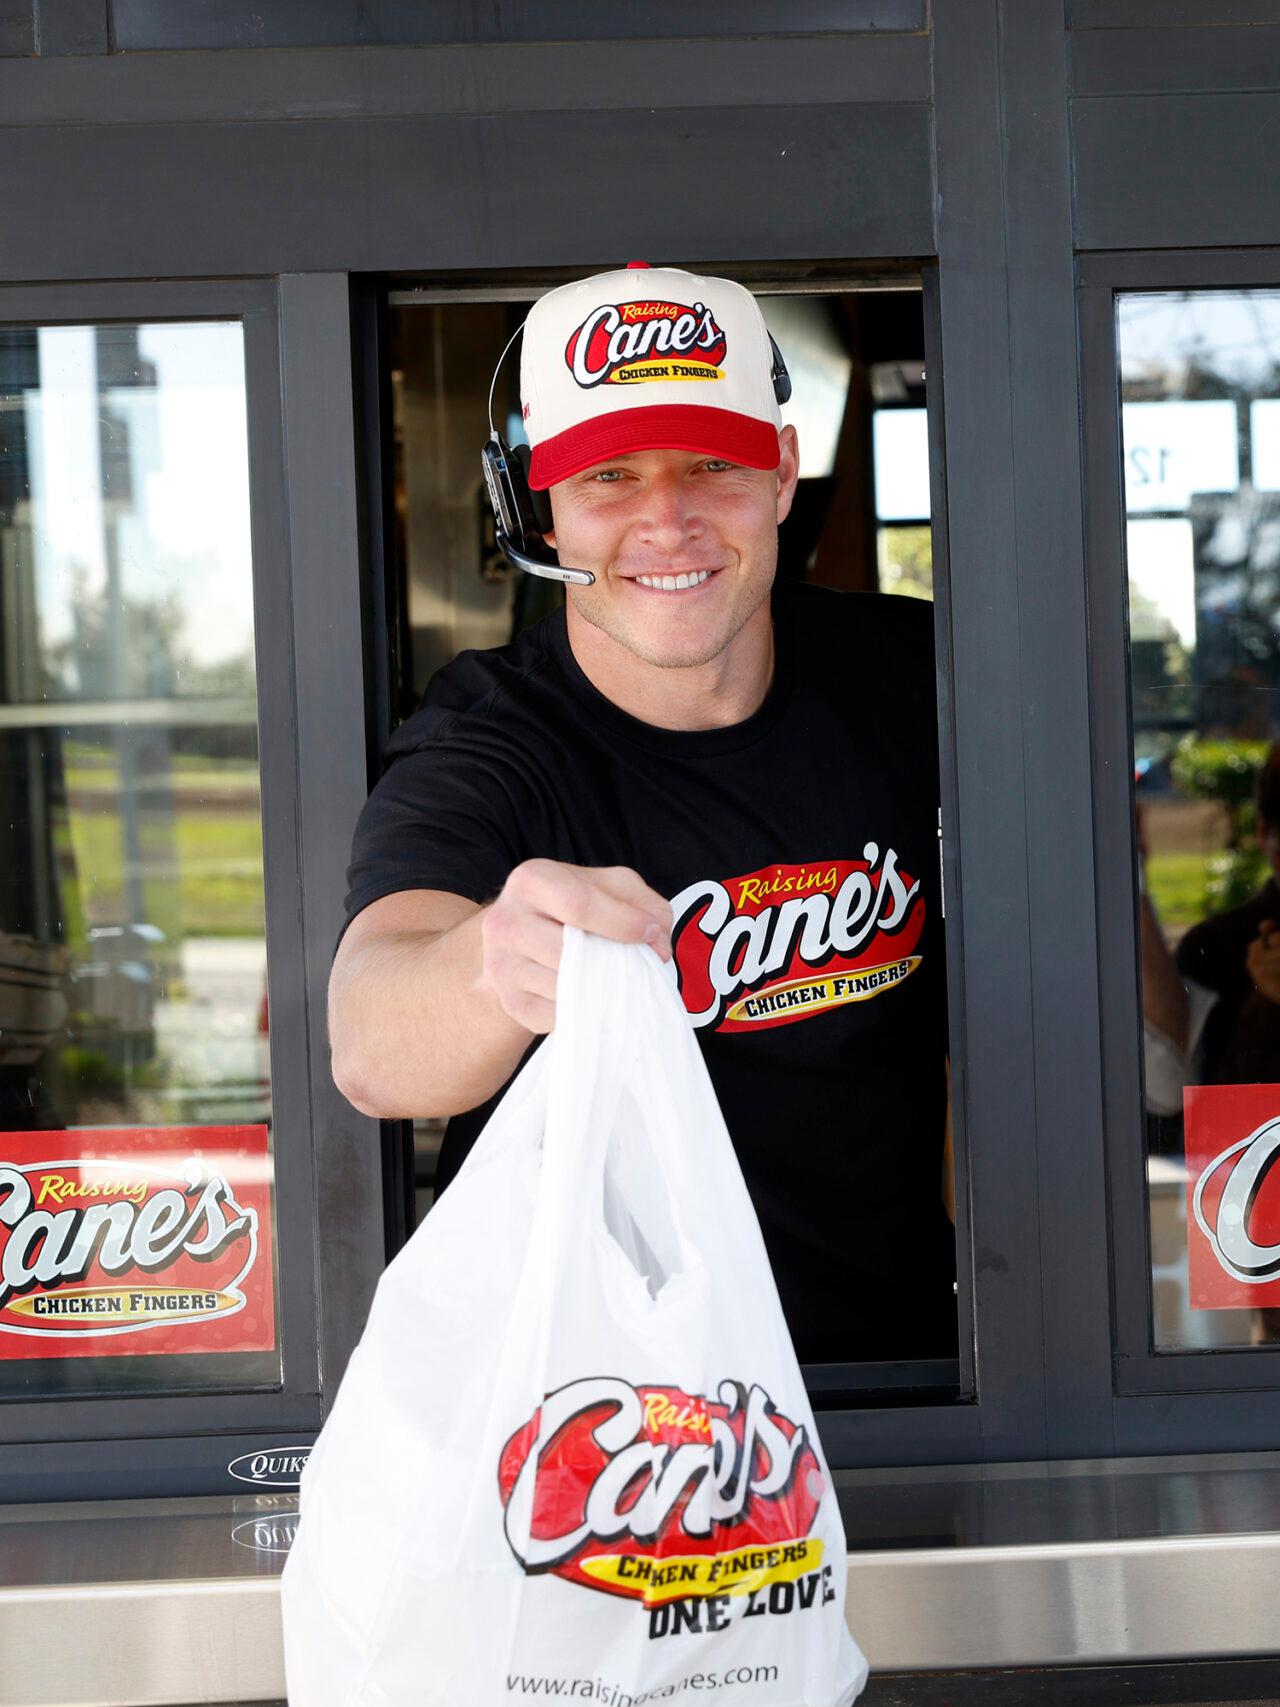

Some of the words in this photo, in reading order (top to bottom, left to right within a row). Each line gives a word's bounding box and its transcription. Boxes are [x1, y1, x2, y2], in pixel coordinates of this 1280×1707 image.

[622, 302, 678, 320] Raising
[573, 302, 723, 386] Cane's
[737, 867, 838, 909] Raising
[744, 983, 826, 1018] CHICKEN
[833, 960, 909, 996] FINGERS
[37, 1174, 149, 1204] Raising
[0, 1167, 247, 1296] ane's
[33, 1293, 122, 1314] CHICKEN
[129, 1293, 217, 1313] FINGERS
[644, 1392, 713, 1433] Raisi
[617, 1556, 699, 1587] CHKEN
[649, 1594, 731, 1639] ONE
[743, 1565, 836, 1618] LOVE
